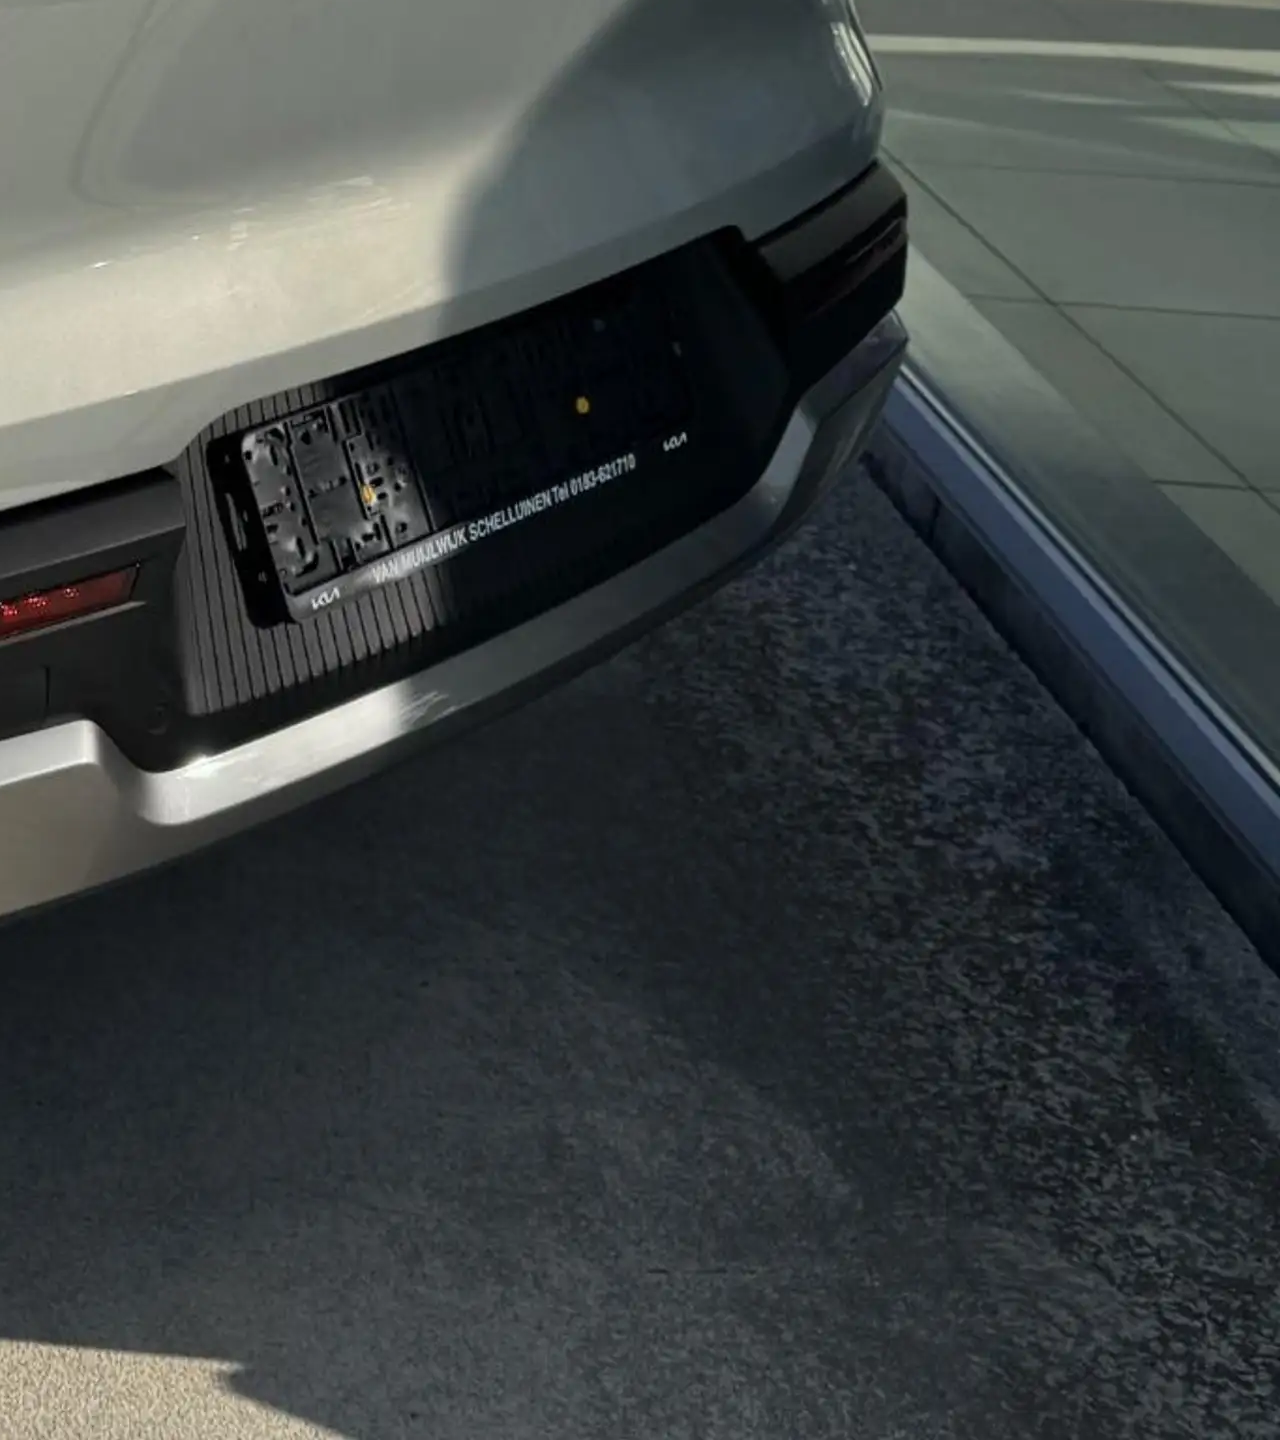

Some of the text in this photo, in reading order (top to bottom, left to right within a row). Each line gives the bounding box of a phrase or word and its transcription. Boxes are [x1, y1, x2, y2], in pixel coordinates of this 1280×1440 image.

[371, 556, 400, 584] VAN
[467, 489, 553, 542] SCHELLUINEN
[550, 480, 570, 504] Tel
[310, 586, 341, 611] KIA
